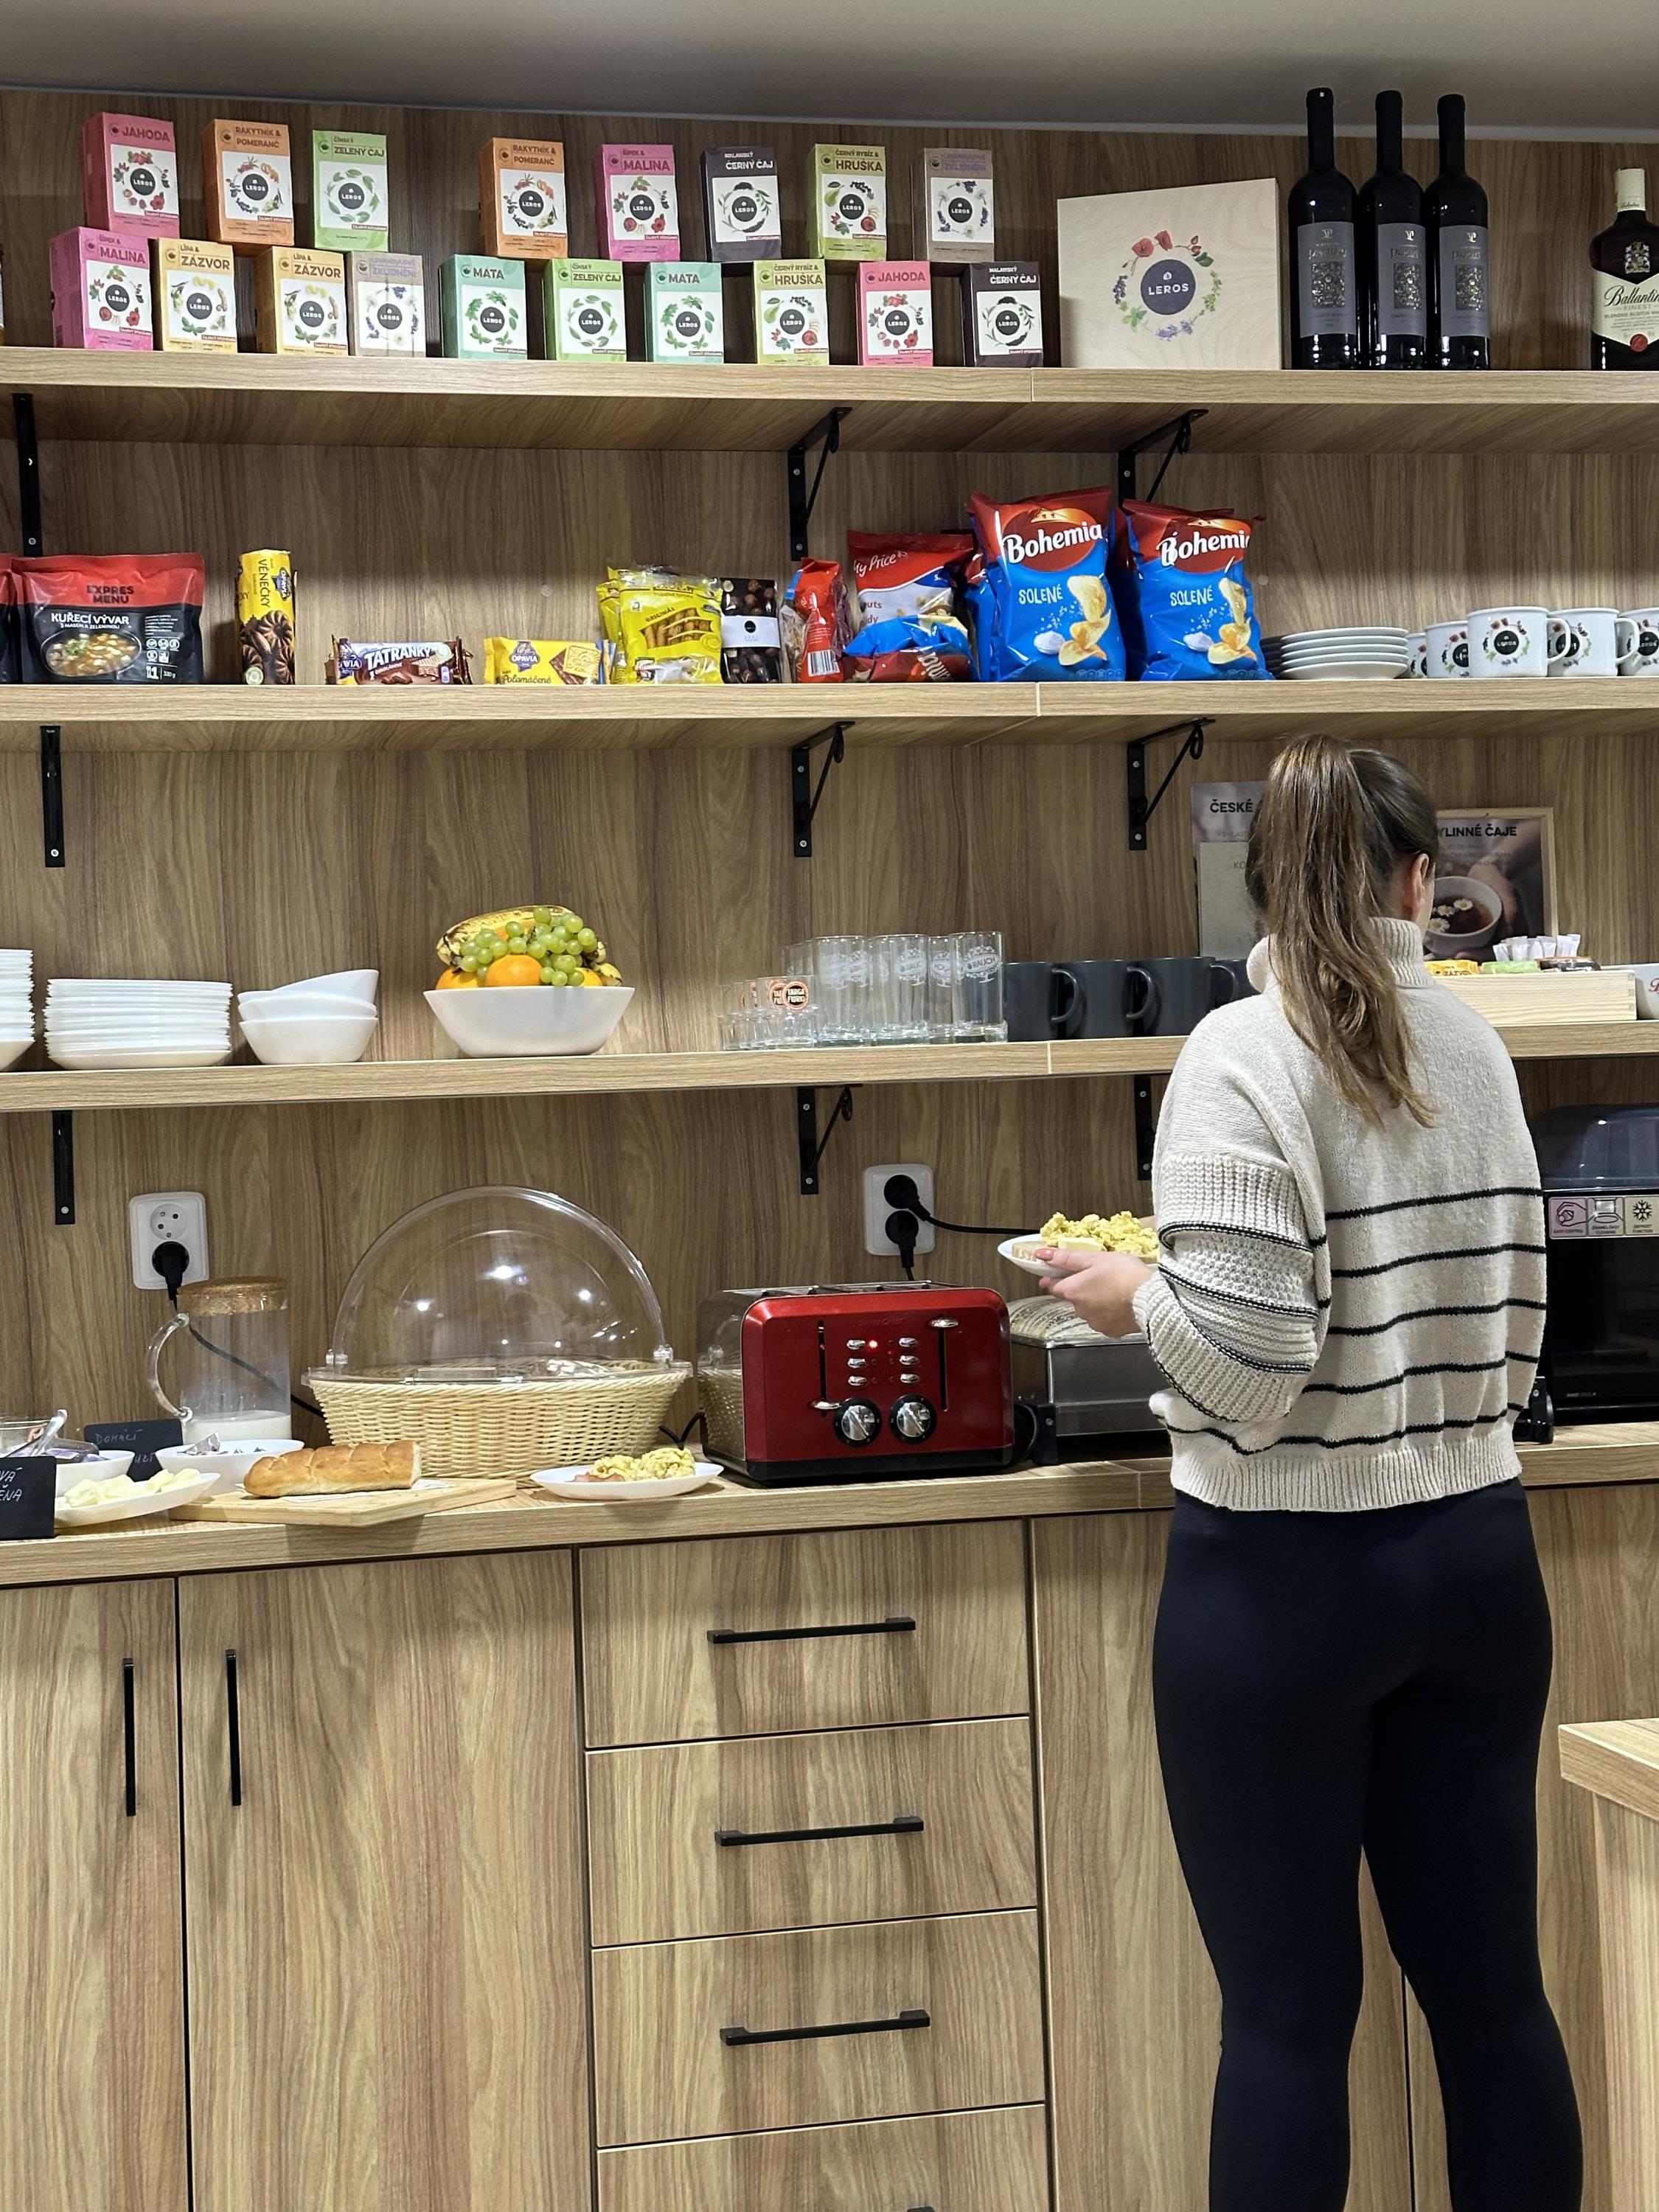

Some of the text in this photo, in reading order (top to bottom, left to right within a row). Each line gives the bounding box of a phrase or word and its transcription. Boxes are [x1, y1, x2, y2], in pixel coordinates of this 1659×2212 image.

[122, 127, 170, 142] JAHODA
[235, 126, 274, 137] RAKYTNÍK
[237, 138, 279, 148] POMERANČ
[513, 144, 549, 154] RAKYTNÍK
[835, 148, 855, 156] ČERNÝ
[514, 156, 554, 165] POMERANČ
[623, 159, 670, 171] MALINA
[726, 159, 773, 170] ČERNÝ ČAJ
[835, 158, 883, 172] HRUŠKA
[133, 179, 153, 187] LEROS
[181, 243, 194, 252] LÍPA
[100, 246, 146, 264] MALINA
[293, 253, 307, 261] LÍPA
[181, 254, 230, 270] ZÁZVOR
[774, 263, 795, 271] ČERNÝ
[294, 263, 341, 278] ZÁZVOR
[878, 271, 925, 282] JAHODA
[775, 273, 824, 285] HRUŠKA
[990, 274, 1036, 285] ČERNÝ ČAJ
[1148, 282, 1189, 296] LEROS
[1002, 521, 1103, 564] Bohemia
[869, 554, 896, 571] Price
[86, 585, 134, 595] EXPRES
[1019, 584, 1063, 605] SOLENÉ
[1170, 585, 1214, 607] SOLENÉ
[93, 594, 129, 604] MENU
[51, 611, 129, 625] KUŘECÍ VÝVAR
[364, 646, 431, 672] TATRANKY
[511, 655, 538, 663] OPAVIA
[502, 673, 552, 685] Polomáčené
[1210, 799, 1253, 813] ČESKÉ
[1485, 823, 1517, 837] ČAJE
[905, 960, 922, 972] RAUC
[973, 957, 996, 969] RAUCH
